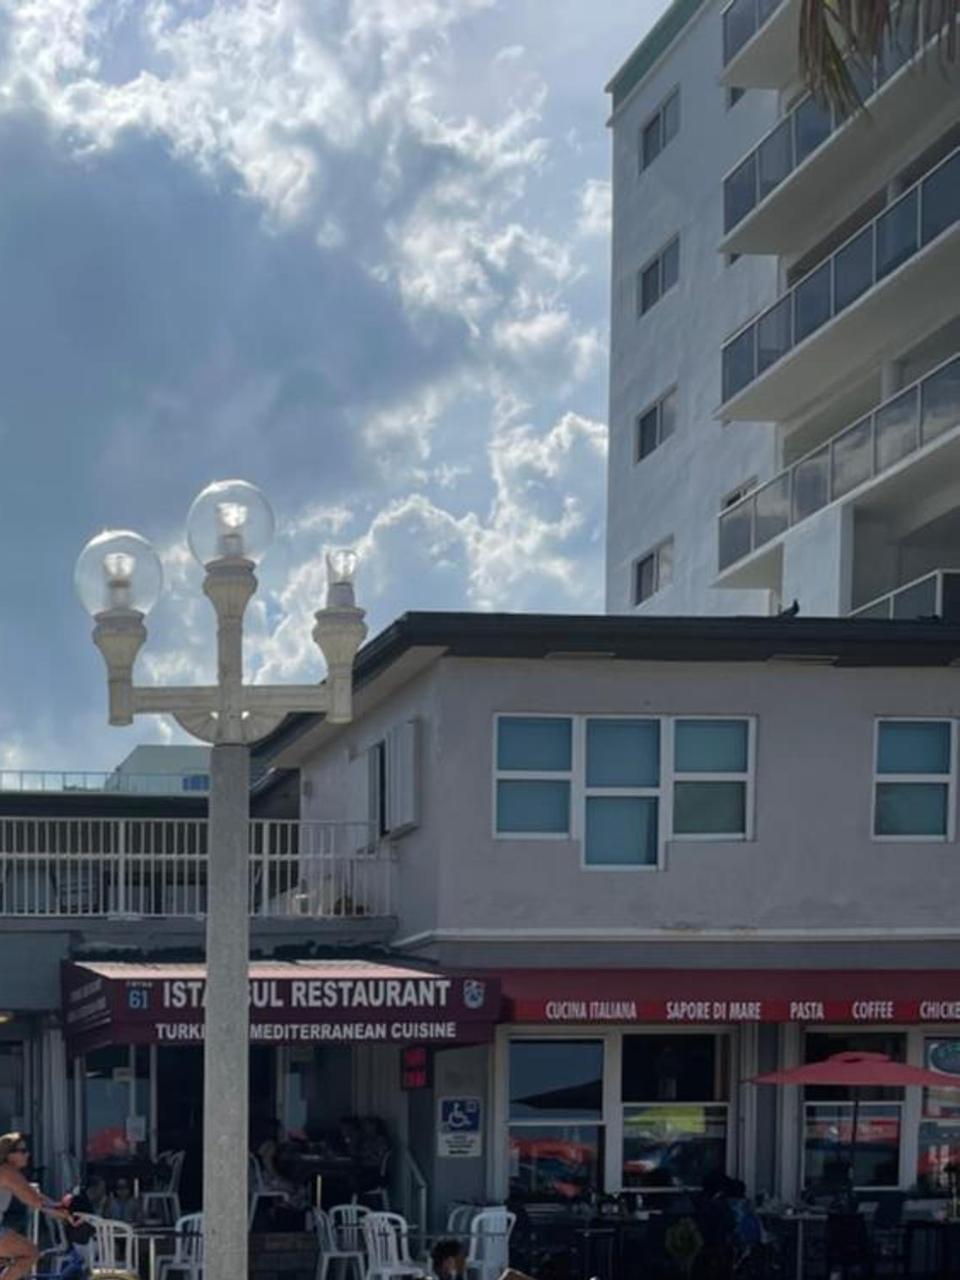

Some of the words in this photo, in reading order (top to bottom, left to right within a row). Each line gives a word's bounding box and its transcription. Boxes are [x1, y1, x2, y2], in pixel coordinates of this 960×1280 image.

[163, 981, 284, 1007] ISTUL
[291, 980, 450, 1008] RESTAURANT
[545, 1001, 588, 1020] CUCINA
[589, 1001, 637, 1020] ITALIANA
[666, 1001, 710, 1020] SAPORE
[713, 1001, 726, 1020] DI
[729, 1001, 761, 1020] MARE
[790, 1001, 824, 1020] PASTA
[852, 1001, 894, 1020] COFFEE
[249, 1023, 386, 1040] MEDITERRANEAN
[390, 1021, 456, 1039] CUISINE
